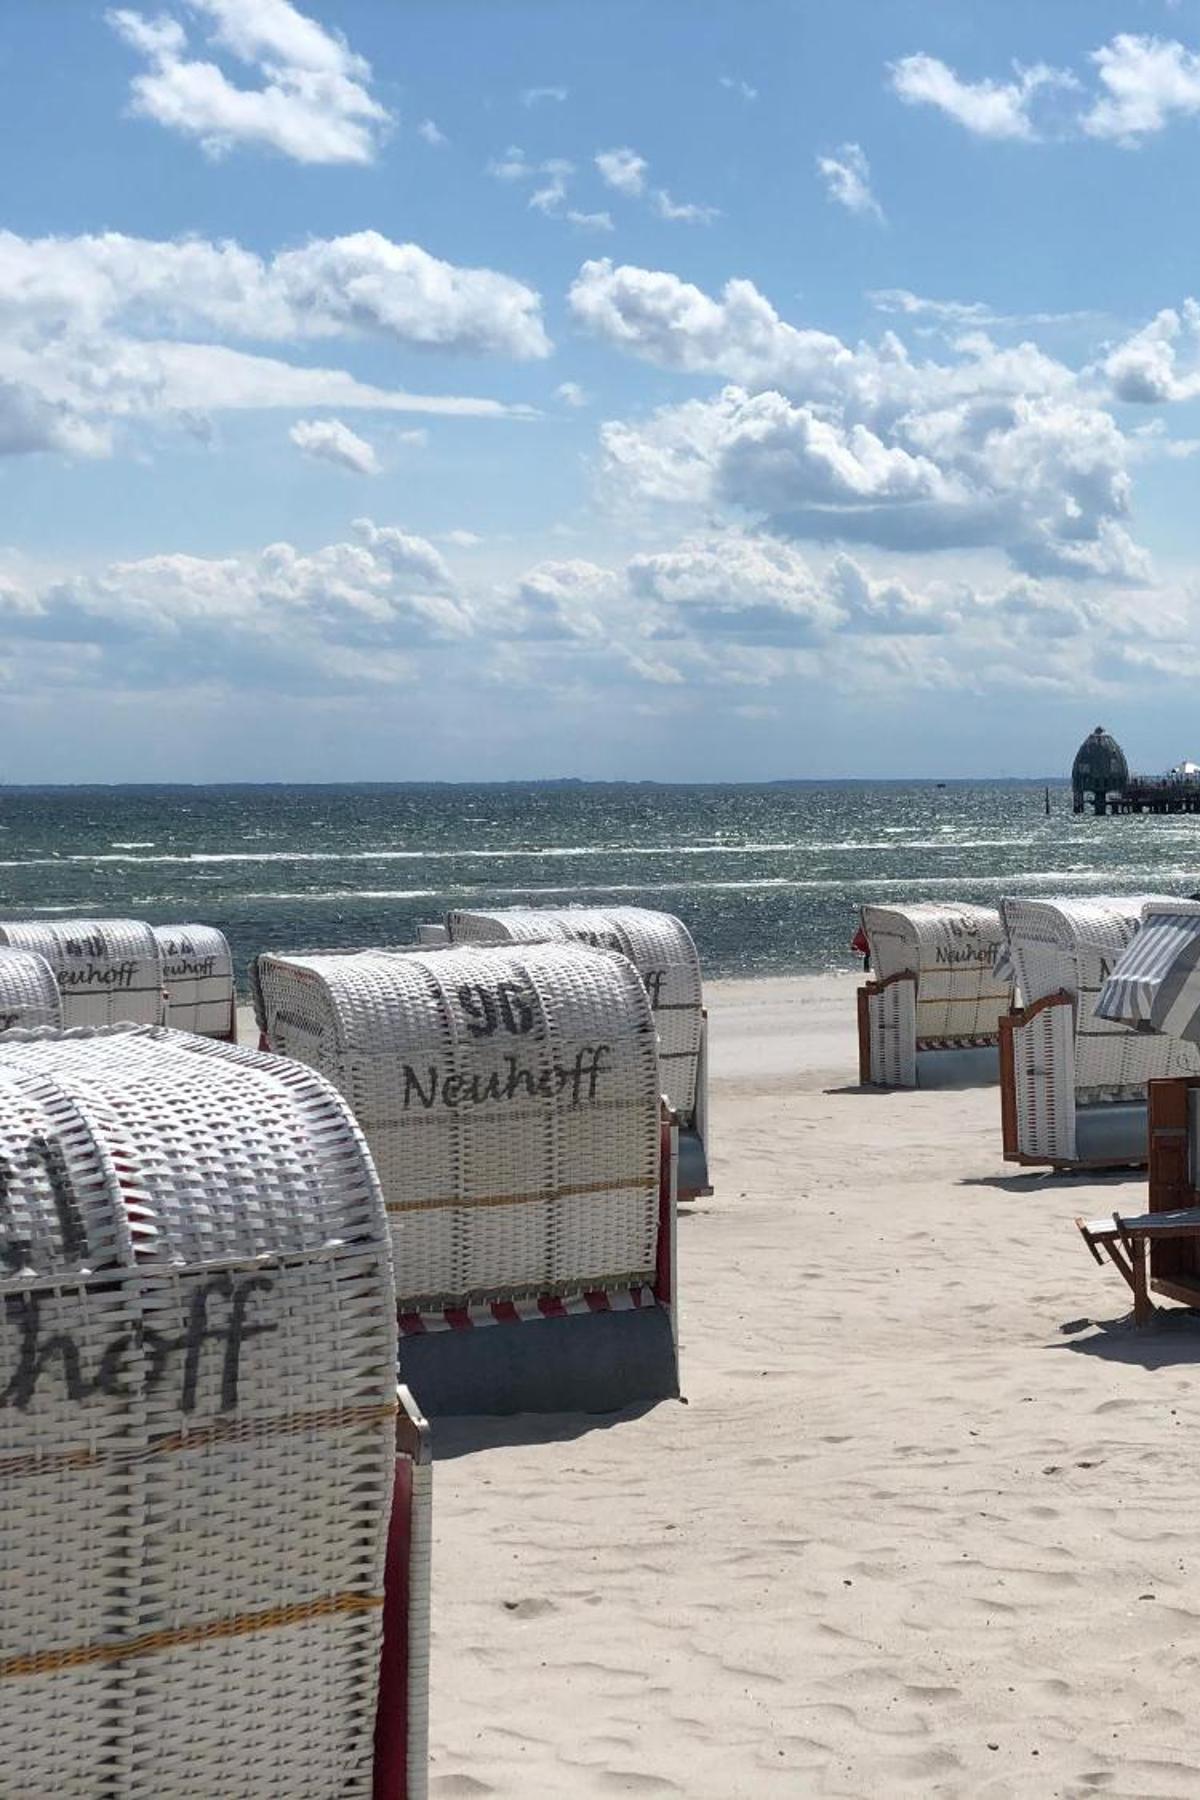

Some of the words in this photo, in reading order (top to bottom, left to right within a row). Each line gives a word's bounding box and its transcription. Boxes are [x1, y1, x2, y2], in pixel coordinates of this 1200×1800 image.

[55, 961, 140, 986] euhoff
[459, 981, 534, 1037] 96
[402, 1044, 612, 1110] Neuhoff
[0, 1274, 279, 1416] hoff
